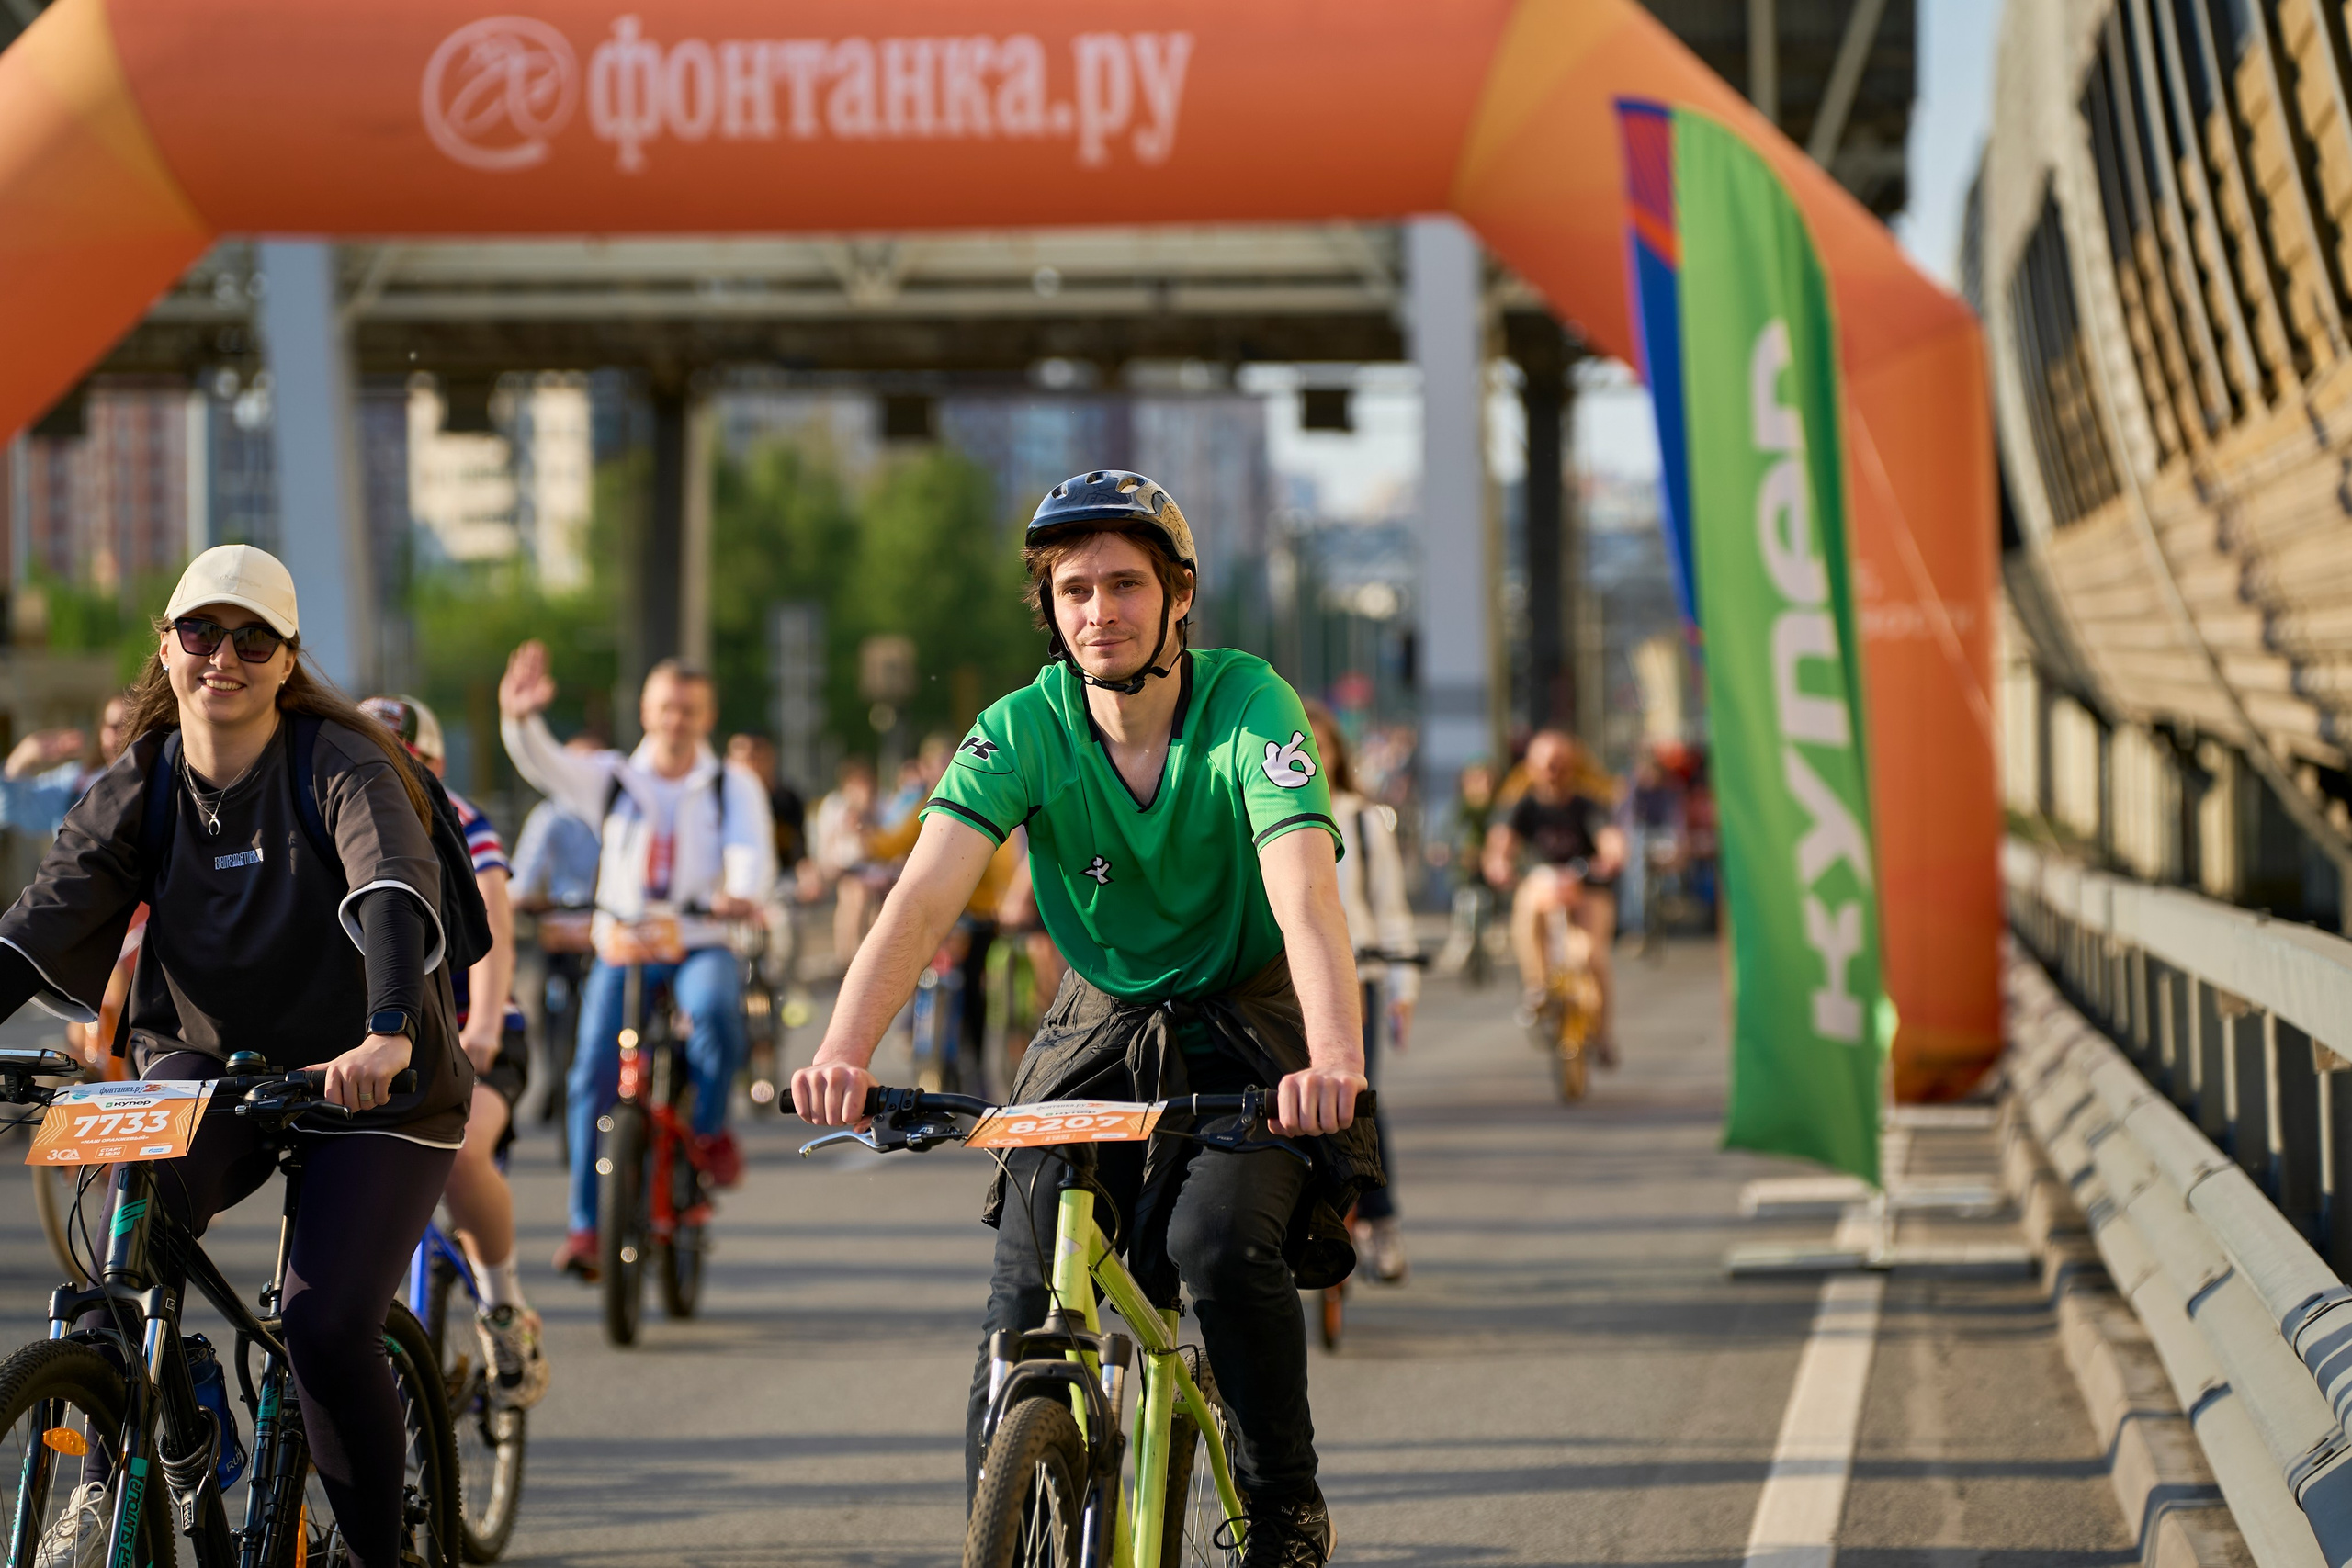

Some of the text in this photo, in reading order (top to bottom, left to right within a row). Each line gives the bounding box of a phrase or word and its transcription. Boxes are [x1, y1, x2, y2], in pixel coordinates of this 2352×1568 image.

[587, 14, 1193, 172] фонтанка.ру
[99, 1086, 144, 1096] фонтанка.ру
[114, 1100, 151, 1108] купер
[74, 1111, 170, 1137] 7733
[1008, 1116, 1125, 1134] 8207
[256, 1438, 269, 1450] M
[119, 1478, 144, 1549] SUNTOUR
